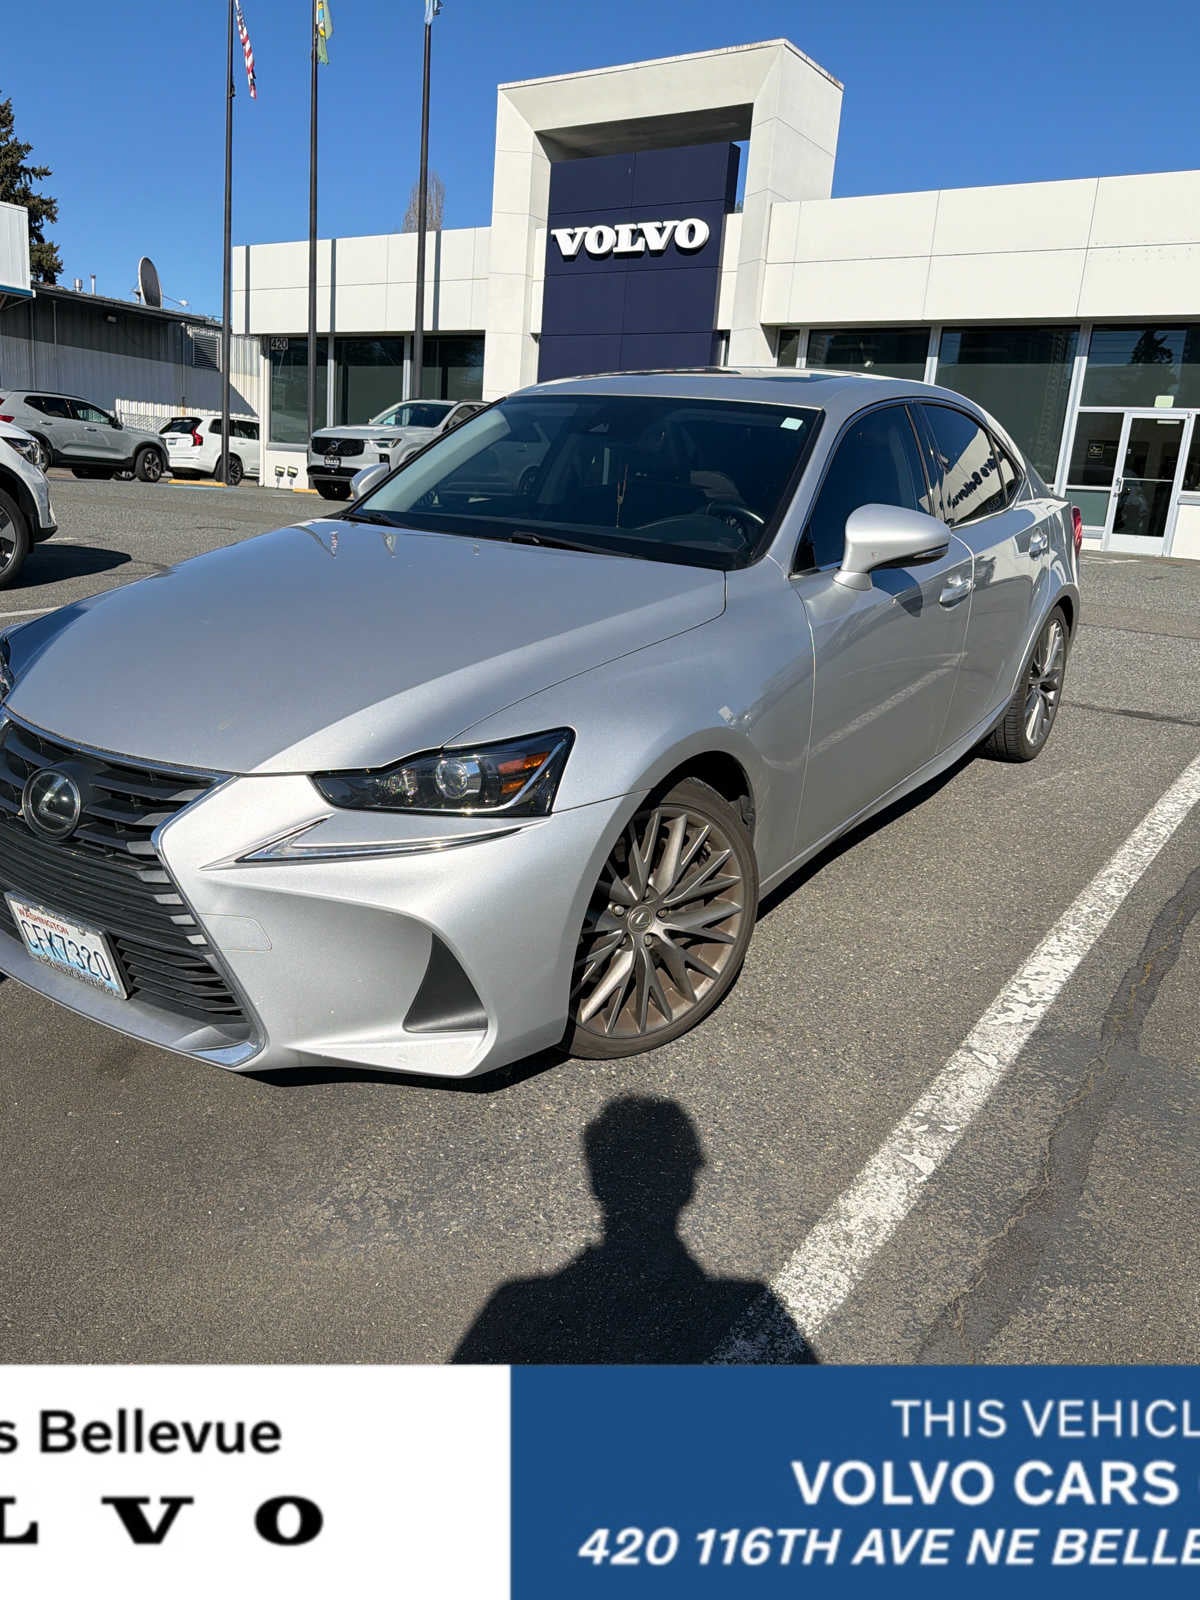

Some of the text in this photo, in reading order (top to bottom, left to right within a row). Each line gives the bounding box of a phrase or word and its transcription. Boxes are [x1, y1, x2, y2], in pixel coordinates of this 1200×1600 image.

[551, 218, 709, 256] VOLVO
[271, 337, 289, 350] 420
[21, 919, 111, 981] CFK7320
